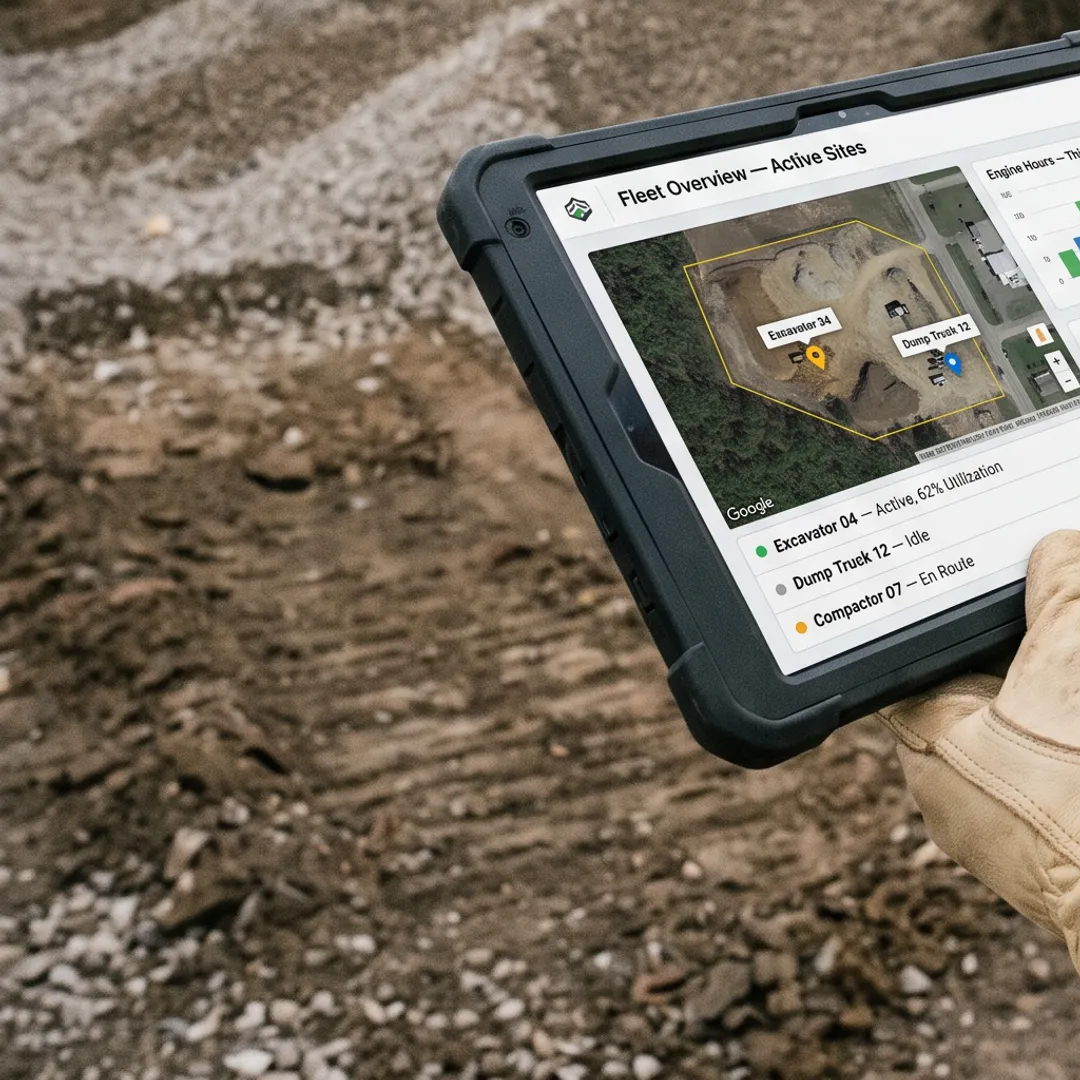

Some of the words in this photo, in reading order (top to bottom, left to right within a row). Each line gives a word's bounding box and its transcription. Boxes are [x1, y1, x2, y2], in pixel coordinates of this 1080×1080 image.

[618, 184, 666, 207] Fleet
[667, 168, 748, 196] Overview
[771, 149, 823, 173] Active
[823, 142, 867, 162] Sites
[986, 164, 1023, 180] Engine
[1022, 156, 1055, 171] Hours
[957, 321, 971, 332] 12
[727, 497, 774, 520] Google
[773, 522, 837, 553] Excavator
[839, 512, 858, 528] 04
[876, 494, 918, 516] Active,
[917, 482, 944, 501] 62%
[792, 568, 833, 590] Dump
[872, 543, 891, 559] 12
[904, 530, 931, 547] Idle
[813, 592, 884, 627] Compactor
[885, 582, 902, 599] 07
[918, 571, 938, 586] En
[937, 557, 975, 578] Route
